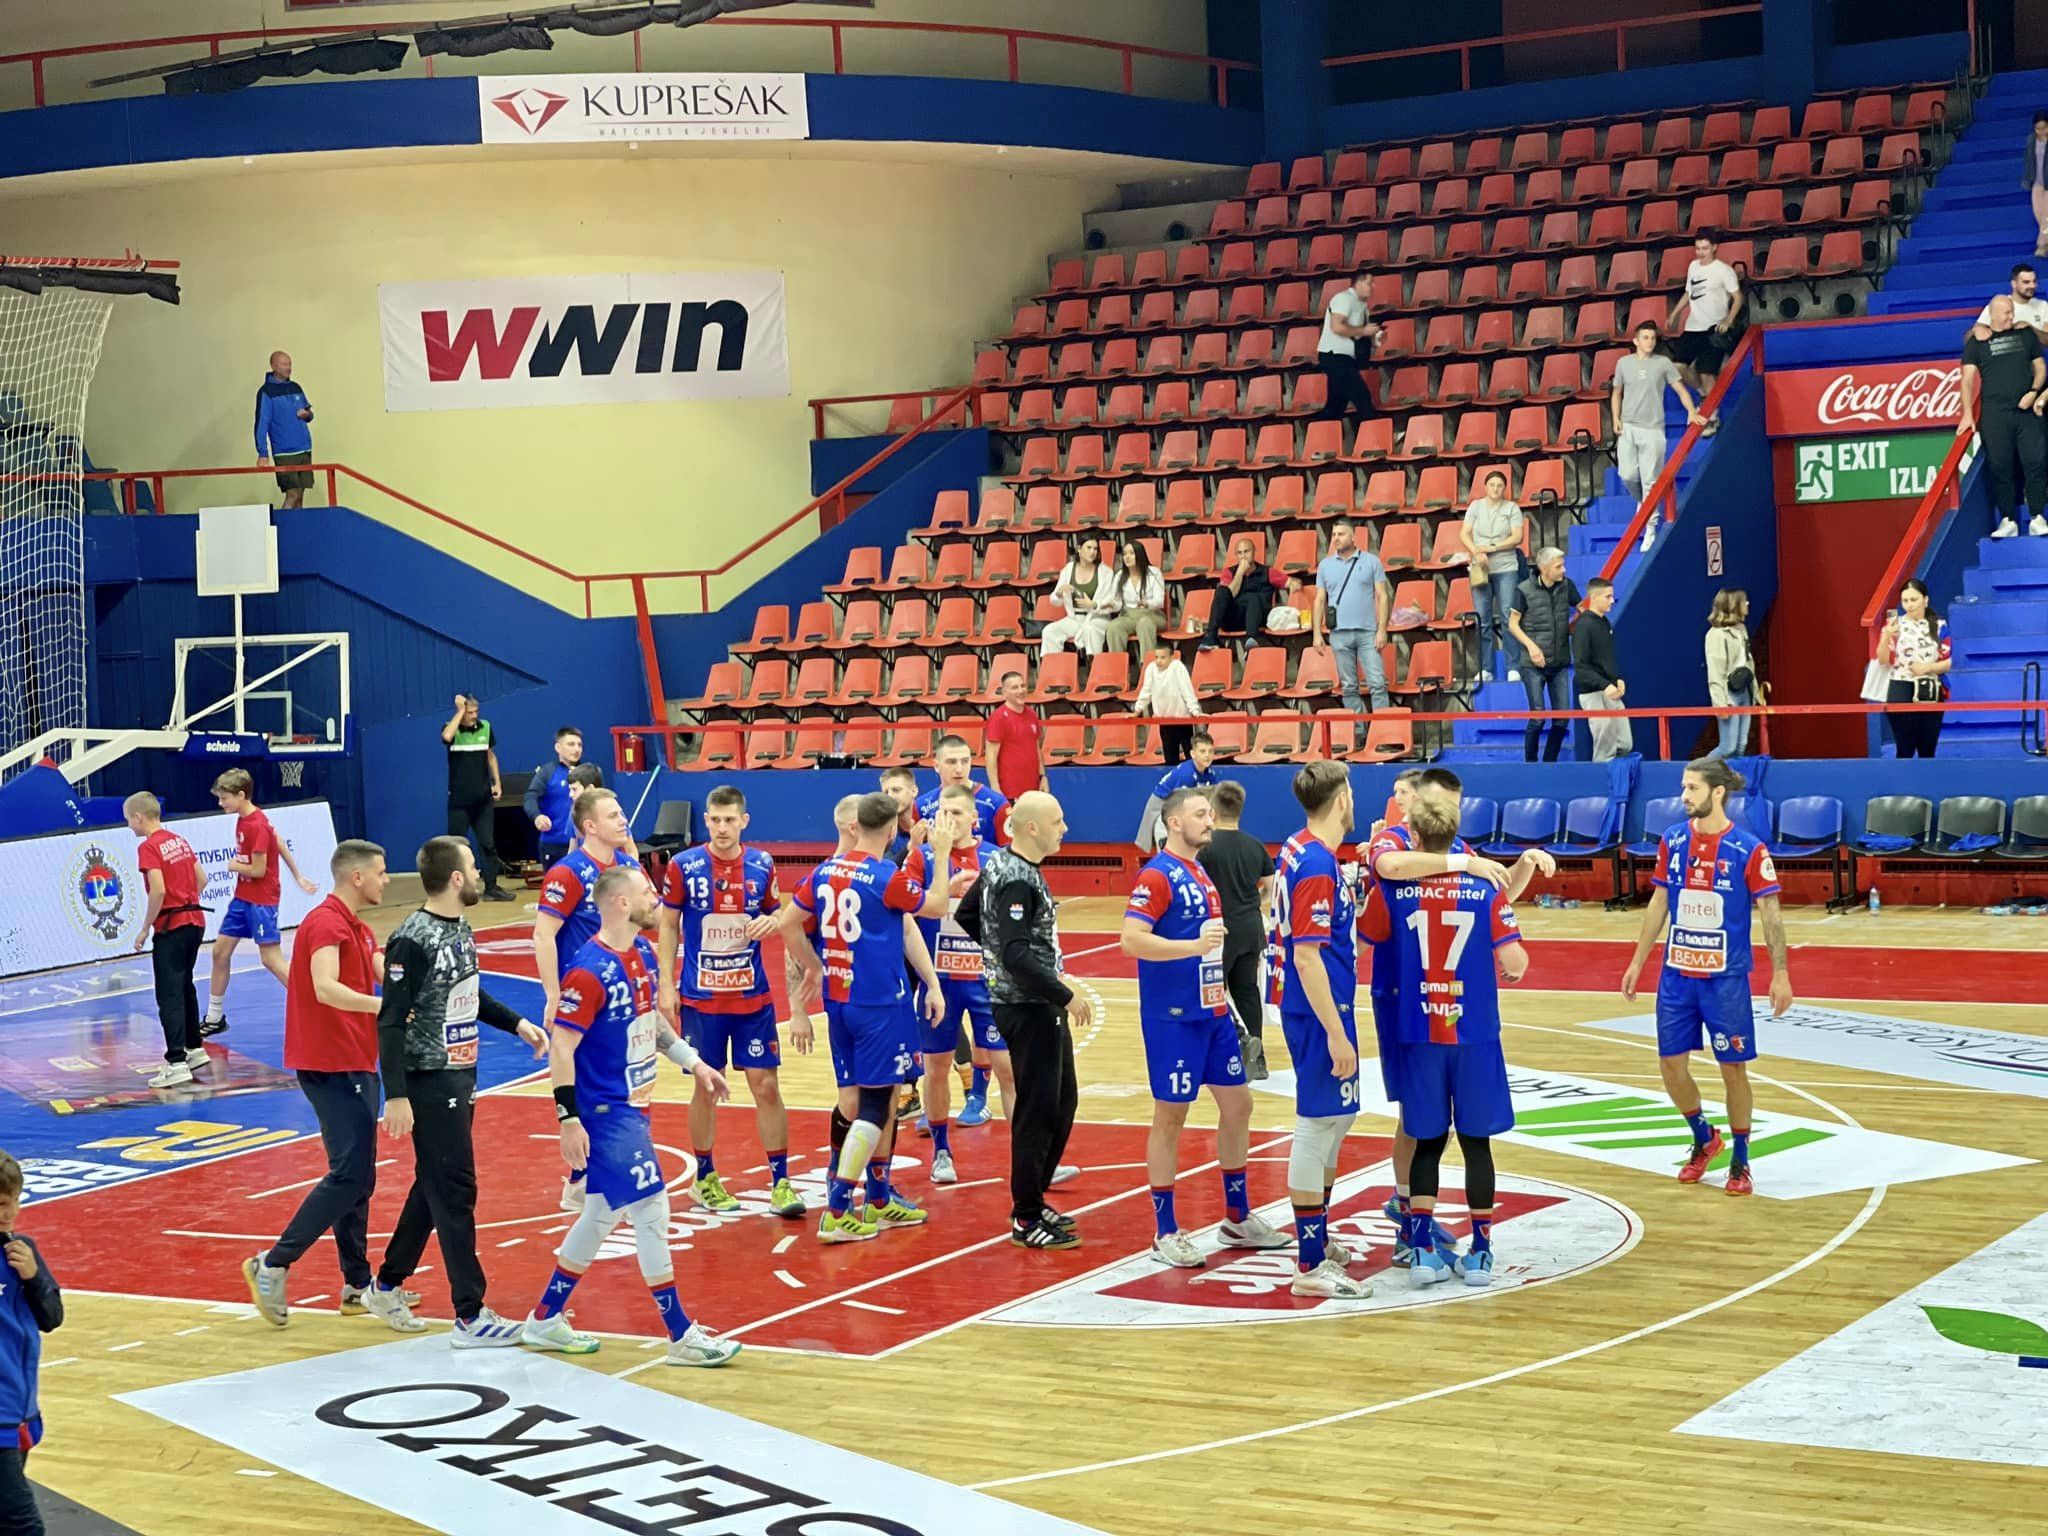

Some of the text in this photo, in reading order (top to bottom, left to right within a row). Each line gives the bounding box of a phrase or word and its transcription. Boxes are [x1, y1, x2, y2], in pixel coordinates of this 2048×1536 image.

[583, 78, 789, 116] KUPREŠAK
[599, 127, 673, 137] WATCHES
[700, 126, 772, 136] JEWELRY
[1818, 367, 1962, 425] Coca-Cola
[1838, 441, 1890, 471] EXIT
[1889, 465, 1948, 495] IZLA
[1669, 852, 1681, 873] 4
[686, 877, 710, 899] 13
[1178, 882, 1204, 907] 15
[1396, 886, 1486, 901] BORAC m:tel
[816, 883, 862, 943] 28
[707, 924, 748, 940] m:tel
[1405, 909, 1476, 971] 17
[434, 944, 458, 971] 41
[1673, 949, 1719, 967] BEMA
[704, 973, 750, 988] BEMA
[607, 981, 632, 1009] 22
[1168, 1071, 1192, 1095] 15
[630, 1160, 660, 1190] 22
